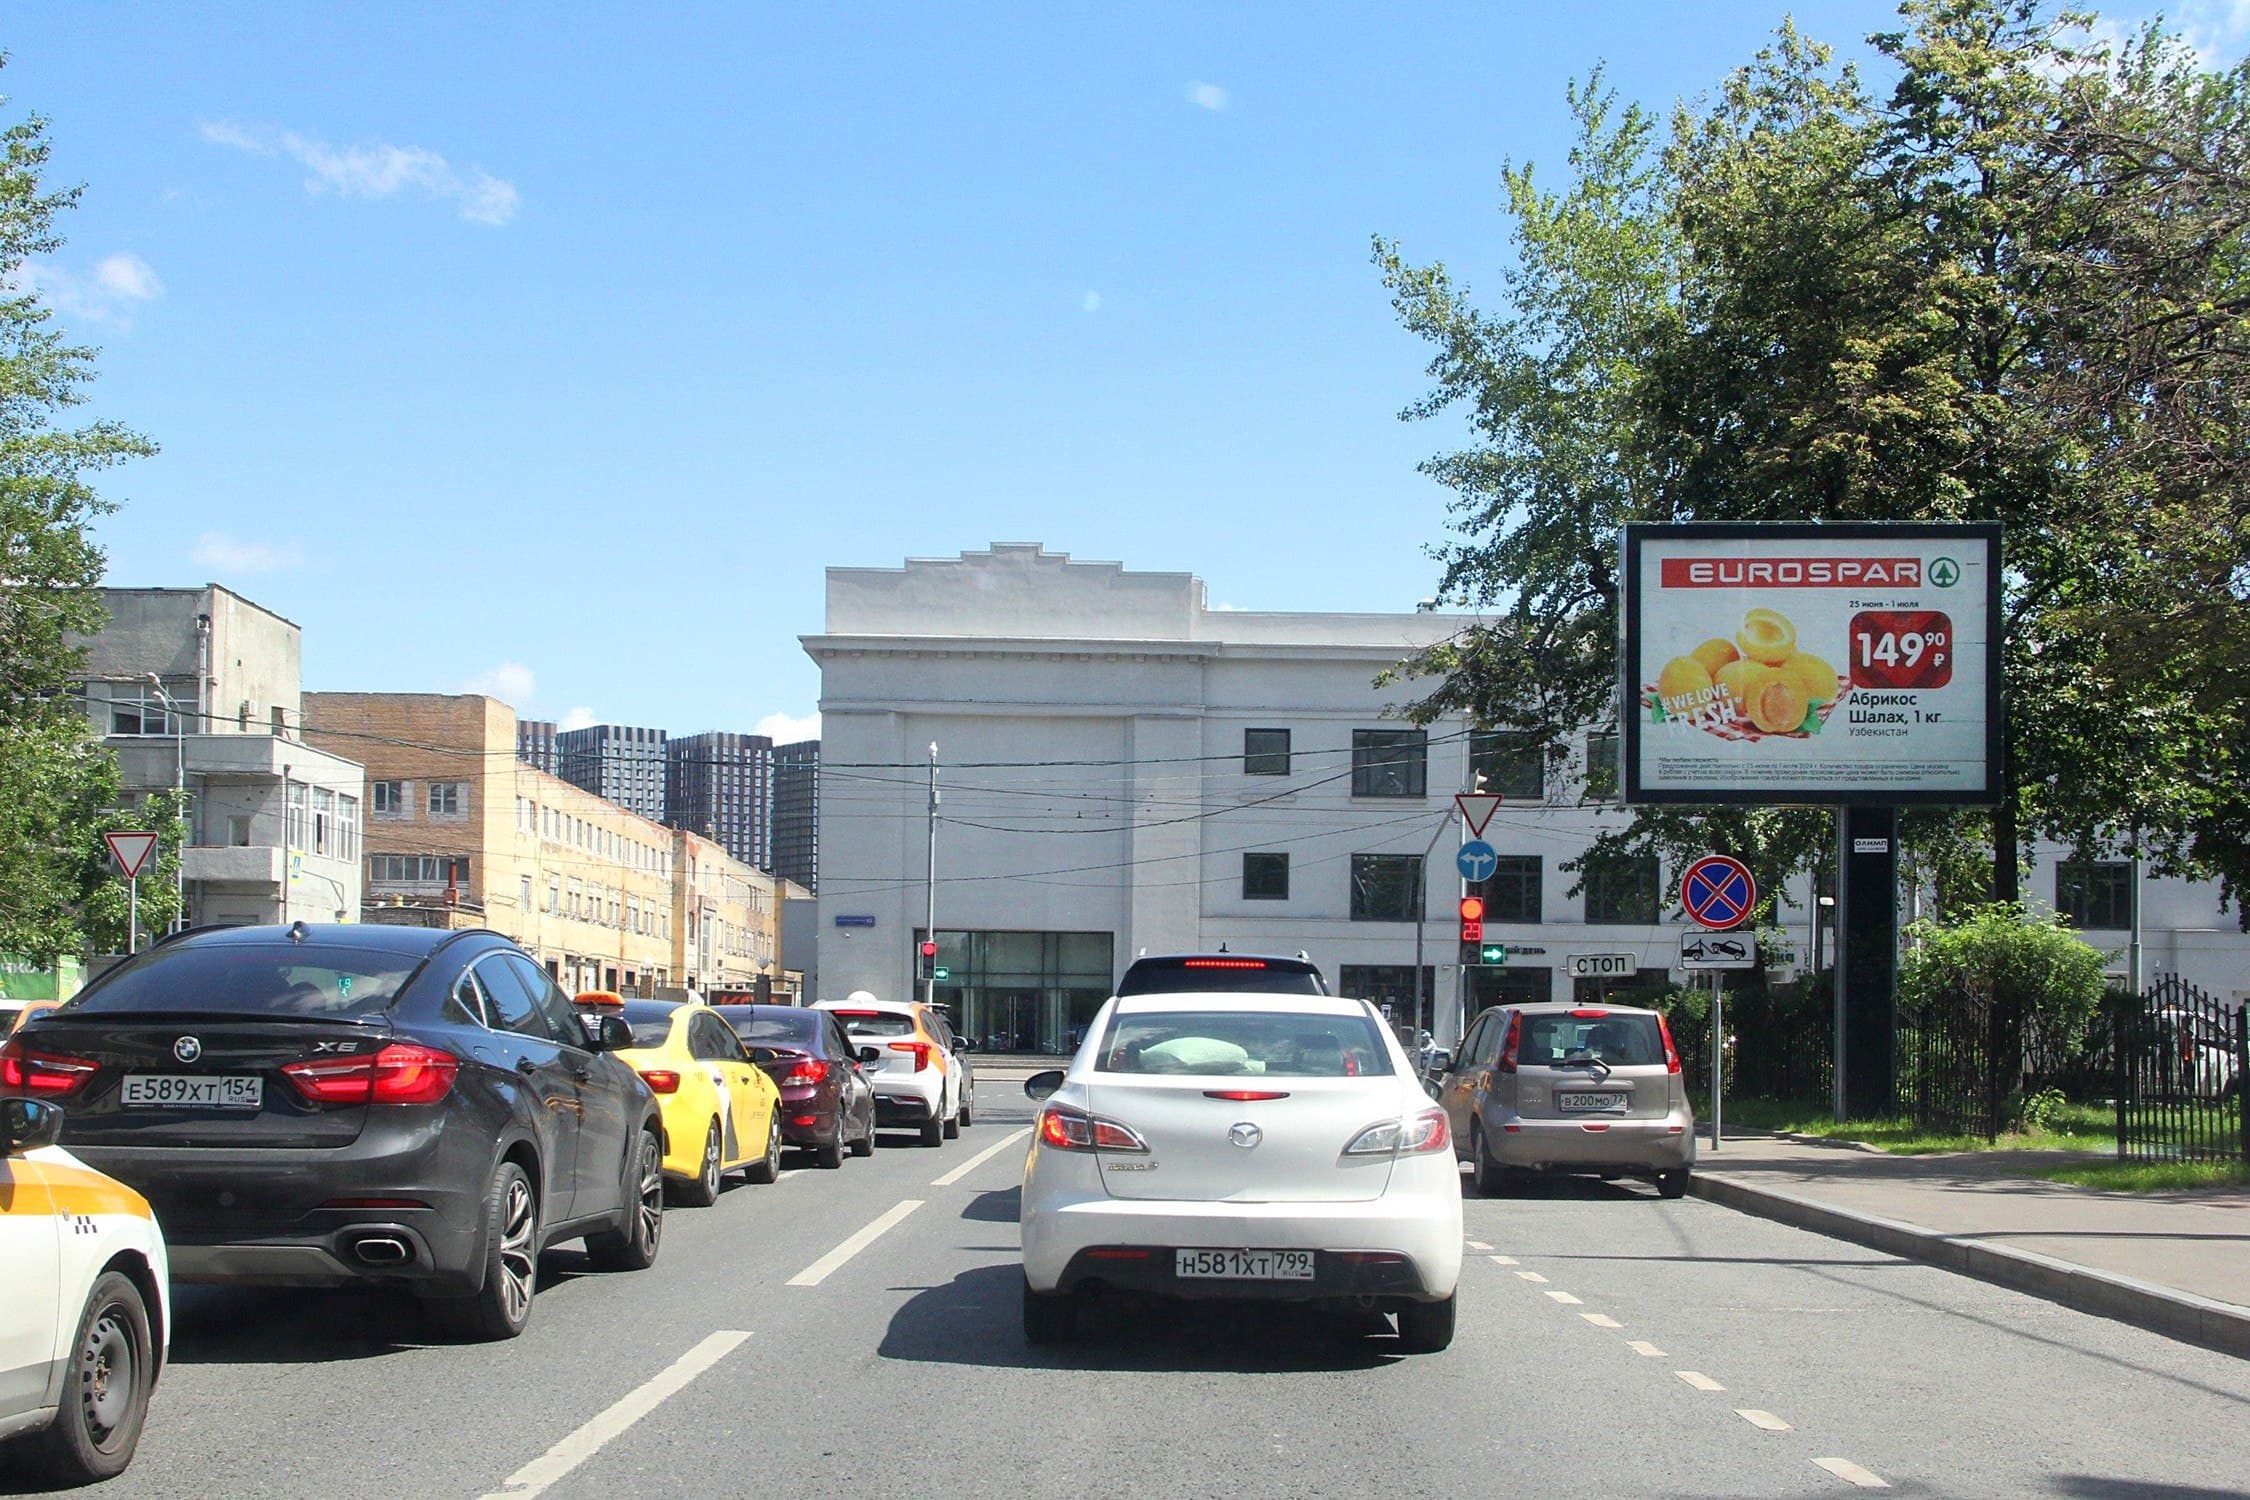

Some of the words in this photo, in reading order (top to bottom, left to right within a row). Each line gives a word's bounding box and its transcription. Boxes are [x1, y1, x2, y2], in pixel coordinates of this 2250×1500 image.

[1689, 562, 1919, 583] EUROSPAR
[1849, 600, 1860, 608] 25
[1857, 632, 1925, 667] 149
[1925, 632, 1945, 646] 90
[1696, 683, 1729, 704] LOVE
[1849, 692, 1917, 709] Абрикос
[1849, 710, 1909, 725] Шалах,
[1914, 710, 1920, 723] 1
[1925, 713, 1942, 723] кг
[1849, 727, 1908, 737] Узбекистан
[1576, 957, 1625, 973] СТОП
[313, 1042, 358, 1052] X6
[128, 1078, 217, 1101] Е589ХТ
[222, 1078, 256, 1096] 154
[1182, 1252, 1270, 1276] Н581ХТ
[1275, 1252, 1309, 1270] 799
